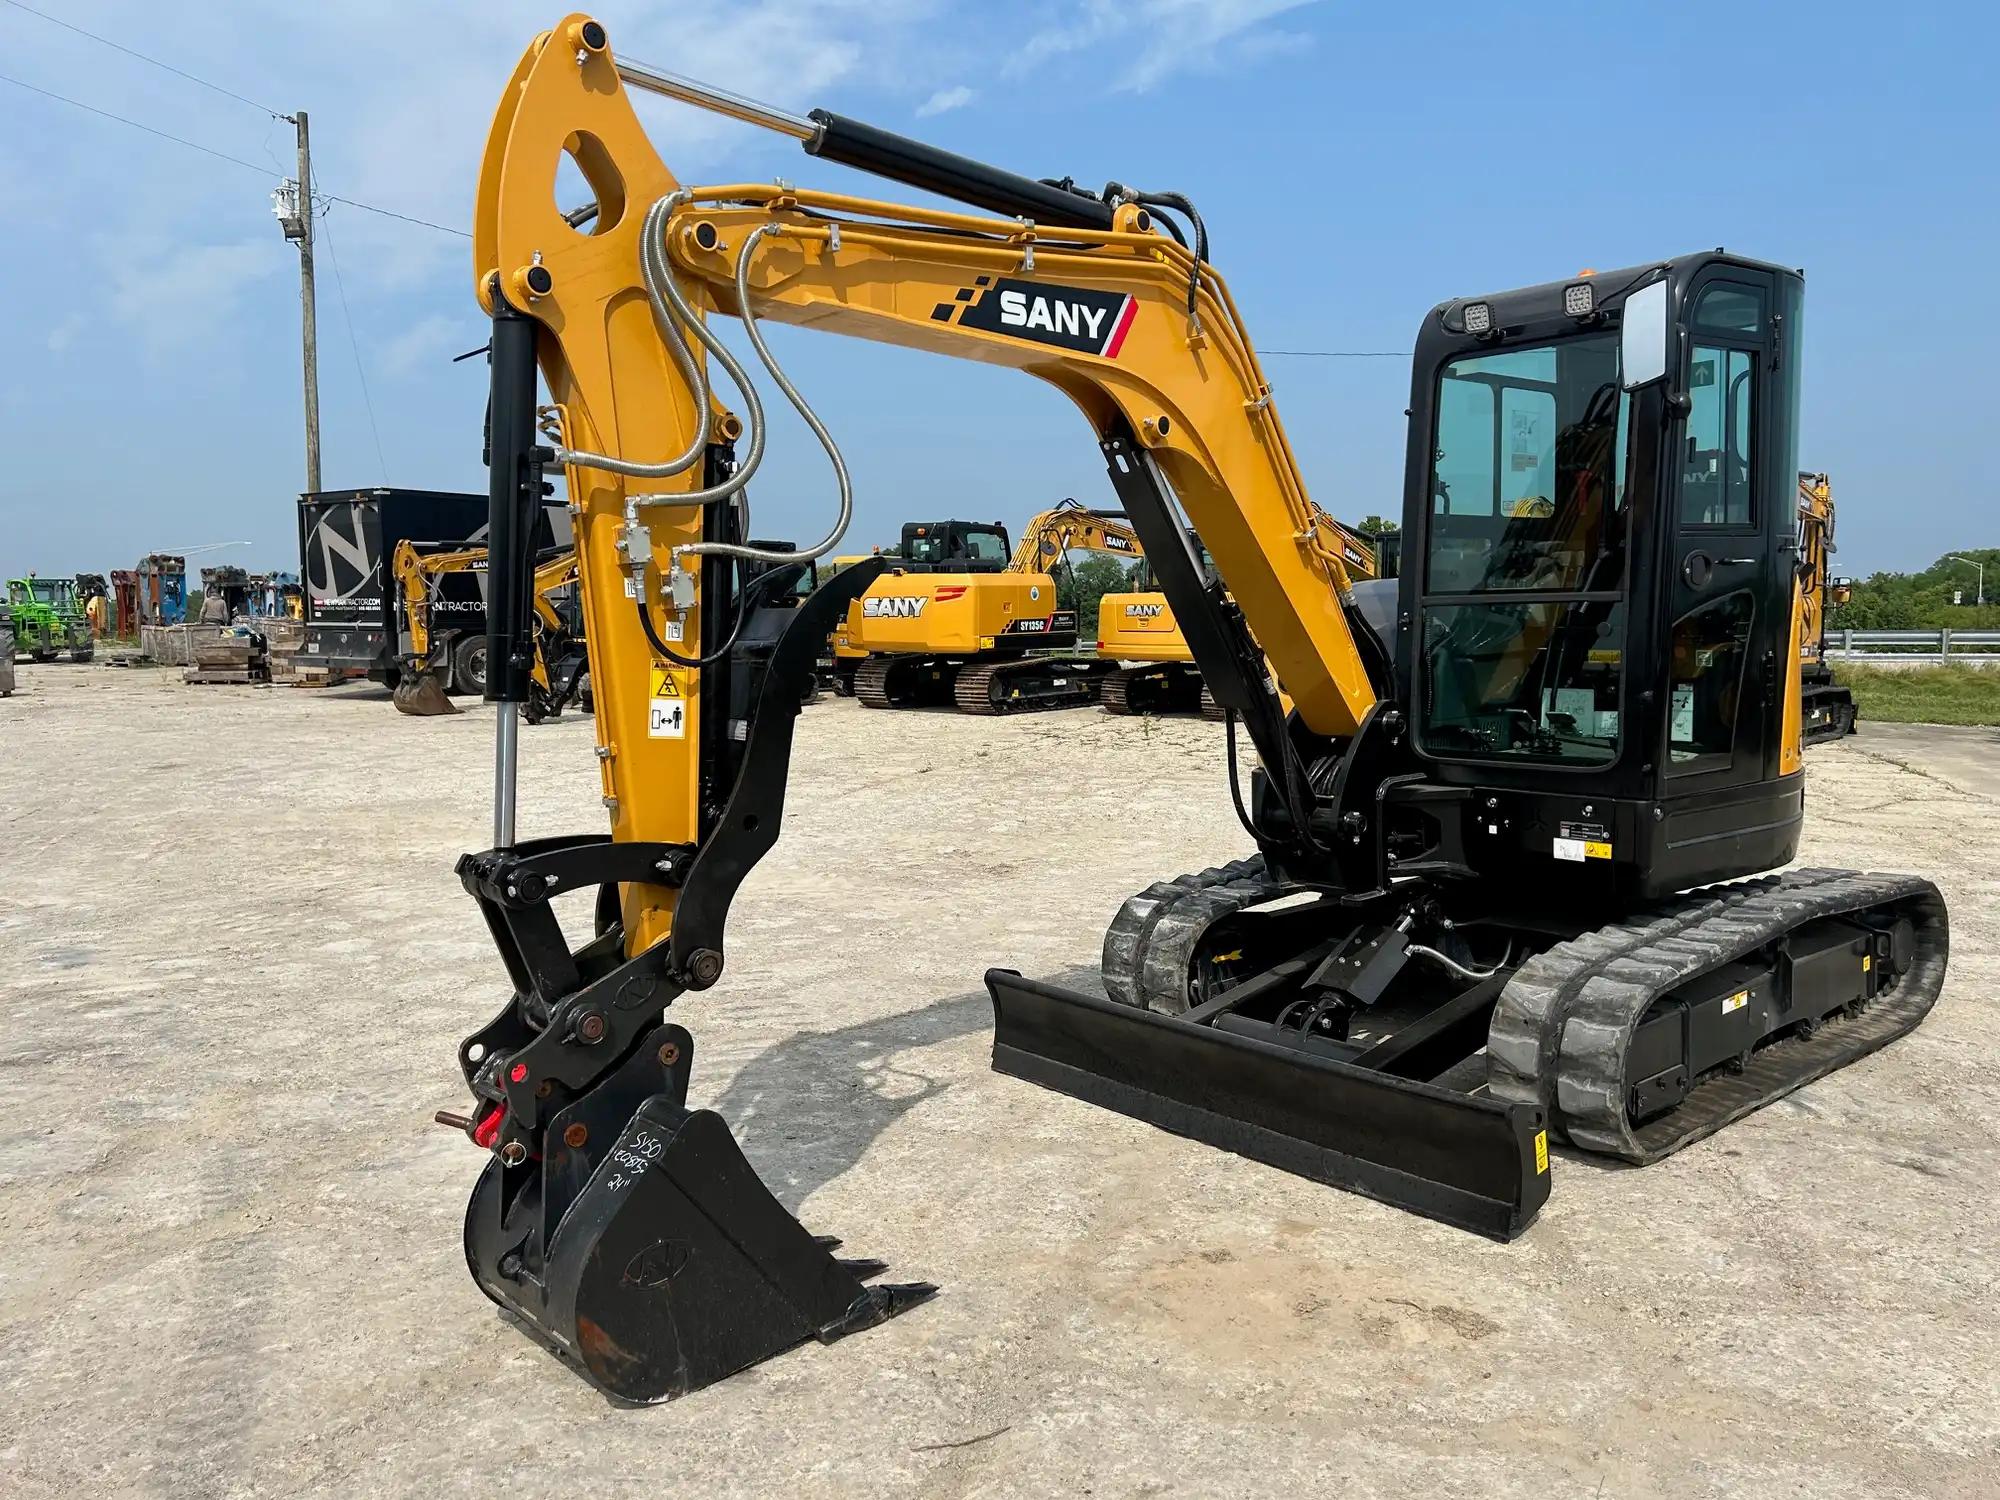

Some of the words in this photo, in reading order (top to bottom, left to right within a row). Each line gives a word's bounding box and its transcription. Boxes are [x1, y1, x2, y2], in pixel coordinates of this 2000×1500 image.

[1000, 290, 1107, 339] SANY
[1106, 536, 1127, 549] SANY
[1344, 547, 1362, 564] SANY
[472, 560, 489, 568] SAN
[863, 596, 929, 618] SANY
[1126, 604, 1164, 618] SANY
[1020, 620, 1045, 631] SY135C
[630, 1131, 662, 1158] SY50
